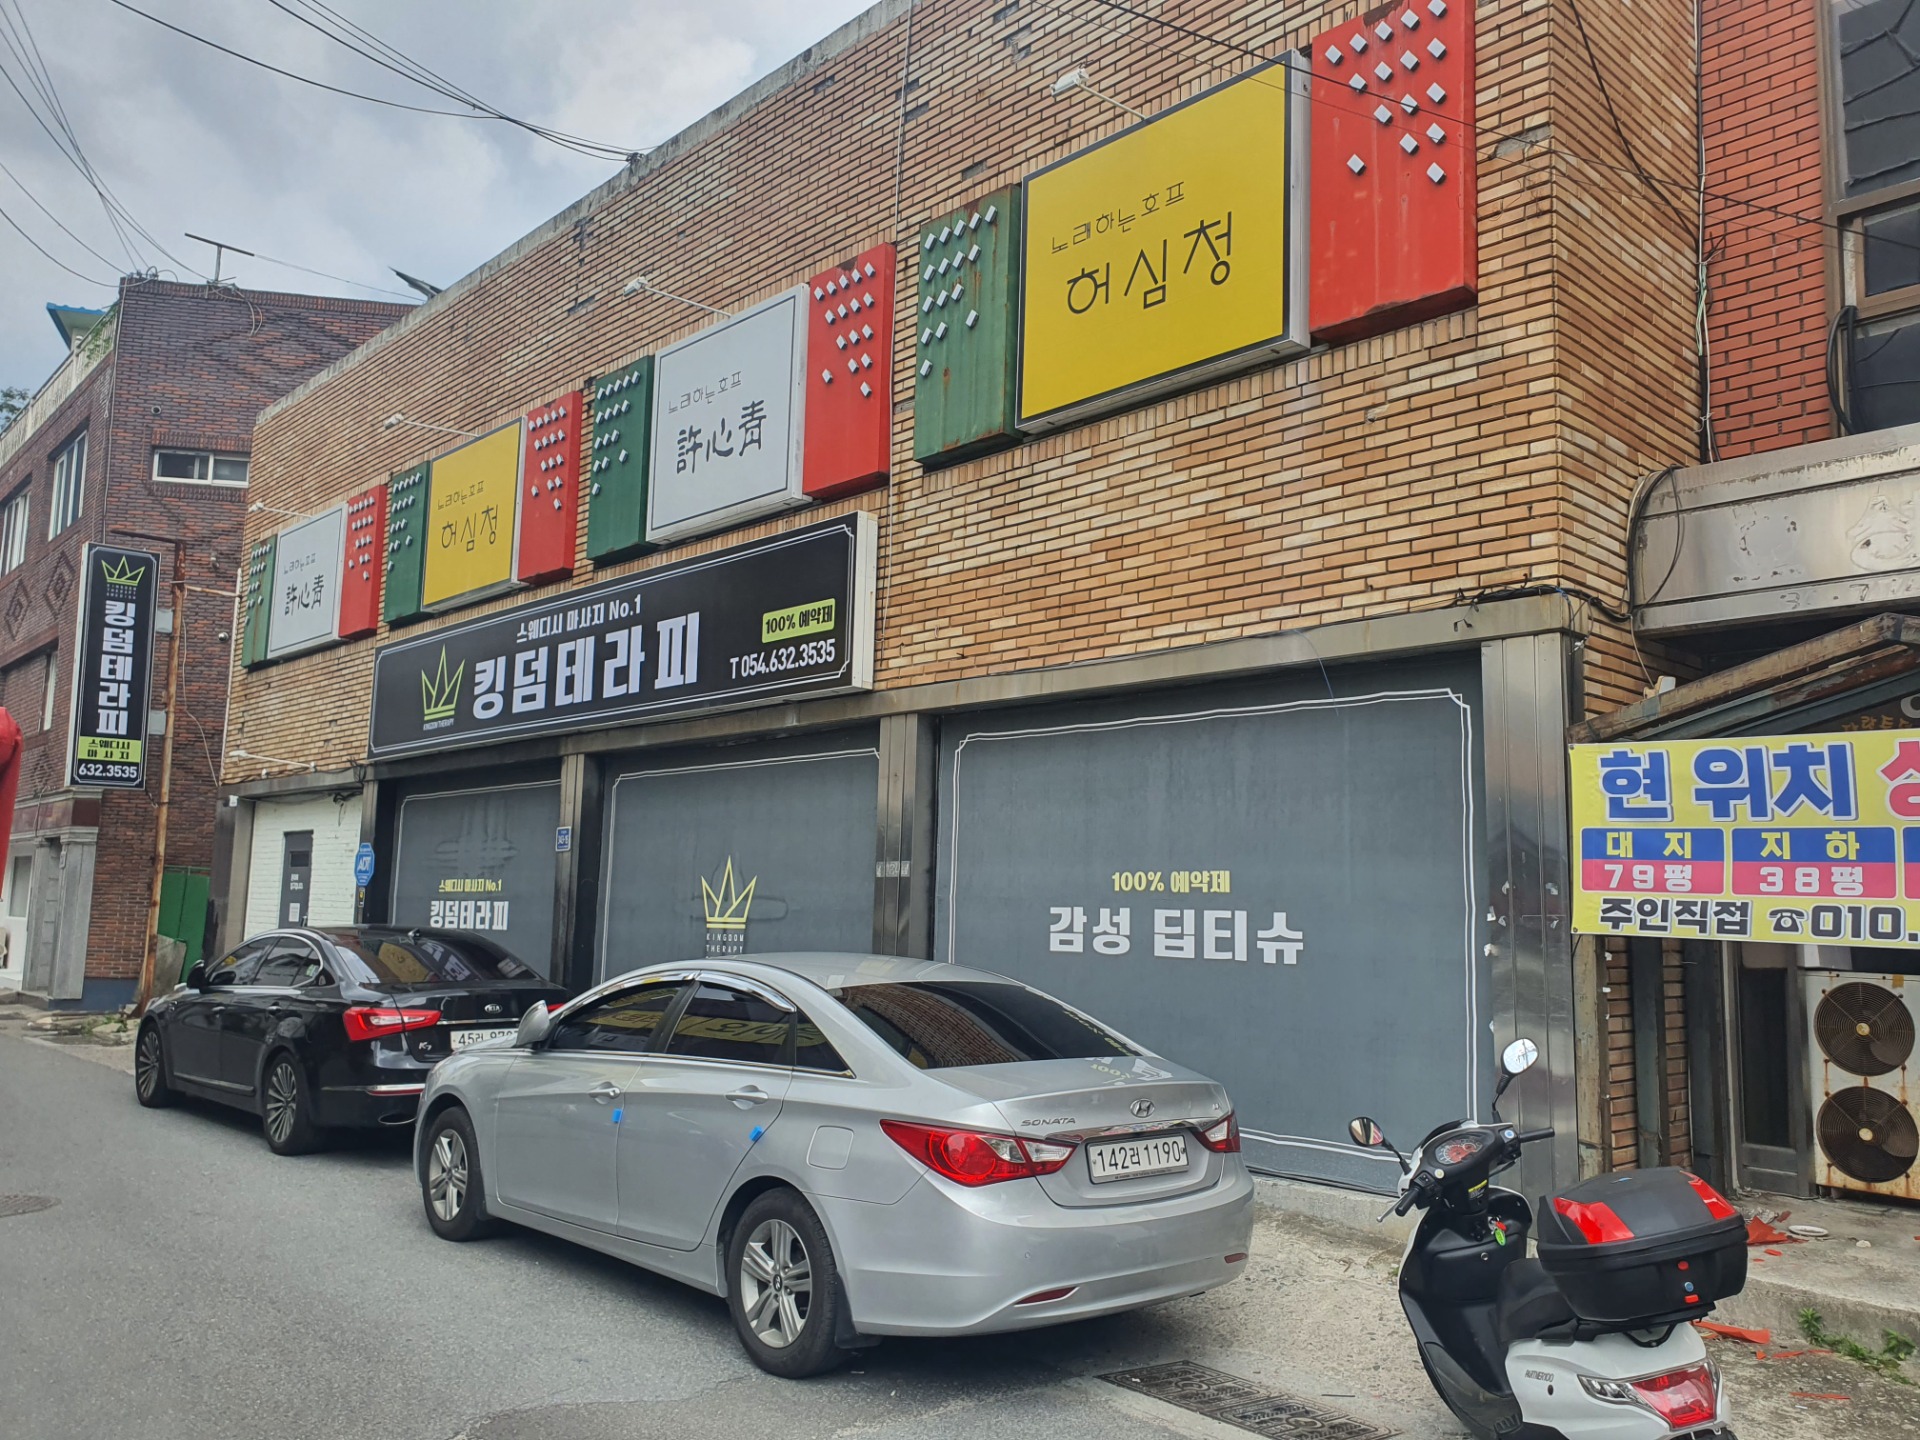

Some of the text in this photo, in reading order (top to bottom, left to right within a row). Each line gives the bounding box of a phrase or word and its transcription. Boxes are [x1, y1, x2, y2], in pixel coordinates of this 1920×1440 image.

[1066, 211, 1233, 315] 허심청
[441, 504, 499, 552] 허심청
[516, 594, 642, 644] 스웨디시 마사지 No.1
[765, 604, 833, 634] 100% 예약제
[96, 600, 136, 736] 킹덤테라피
[472, 611, 700, 720] 킹덤테라피
[730, 638, 836, 679] T 054.632.3535
[78, 763, 138, 778] 632.3535
[1599, 750, 1671, 820] 현
[1692, 742, 1854, 820] 위치
[357, 856, 371, 871] ADT
[485, 878, 502, 892] No.1
[1112, 870, 1230, 893] 100% 예약제
[430, 900, 509, 931] 킹덤테라피
[1600, 898, 1751, 936] 주인직접
[705, 944, 743, 953] THERAPY
[706, 933, 745, 942] KINGDOM
[1049, 906, 1304, 965] 감성 딥티슈
[1021, 1117, 1076, 1127] SONATA
